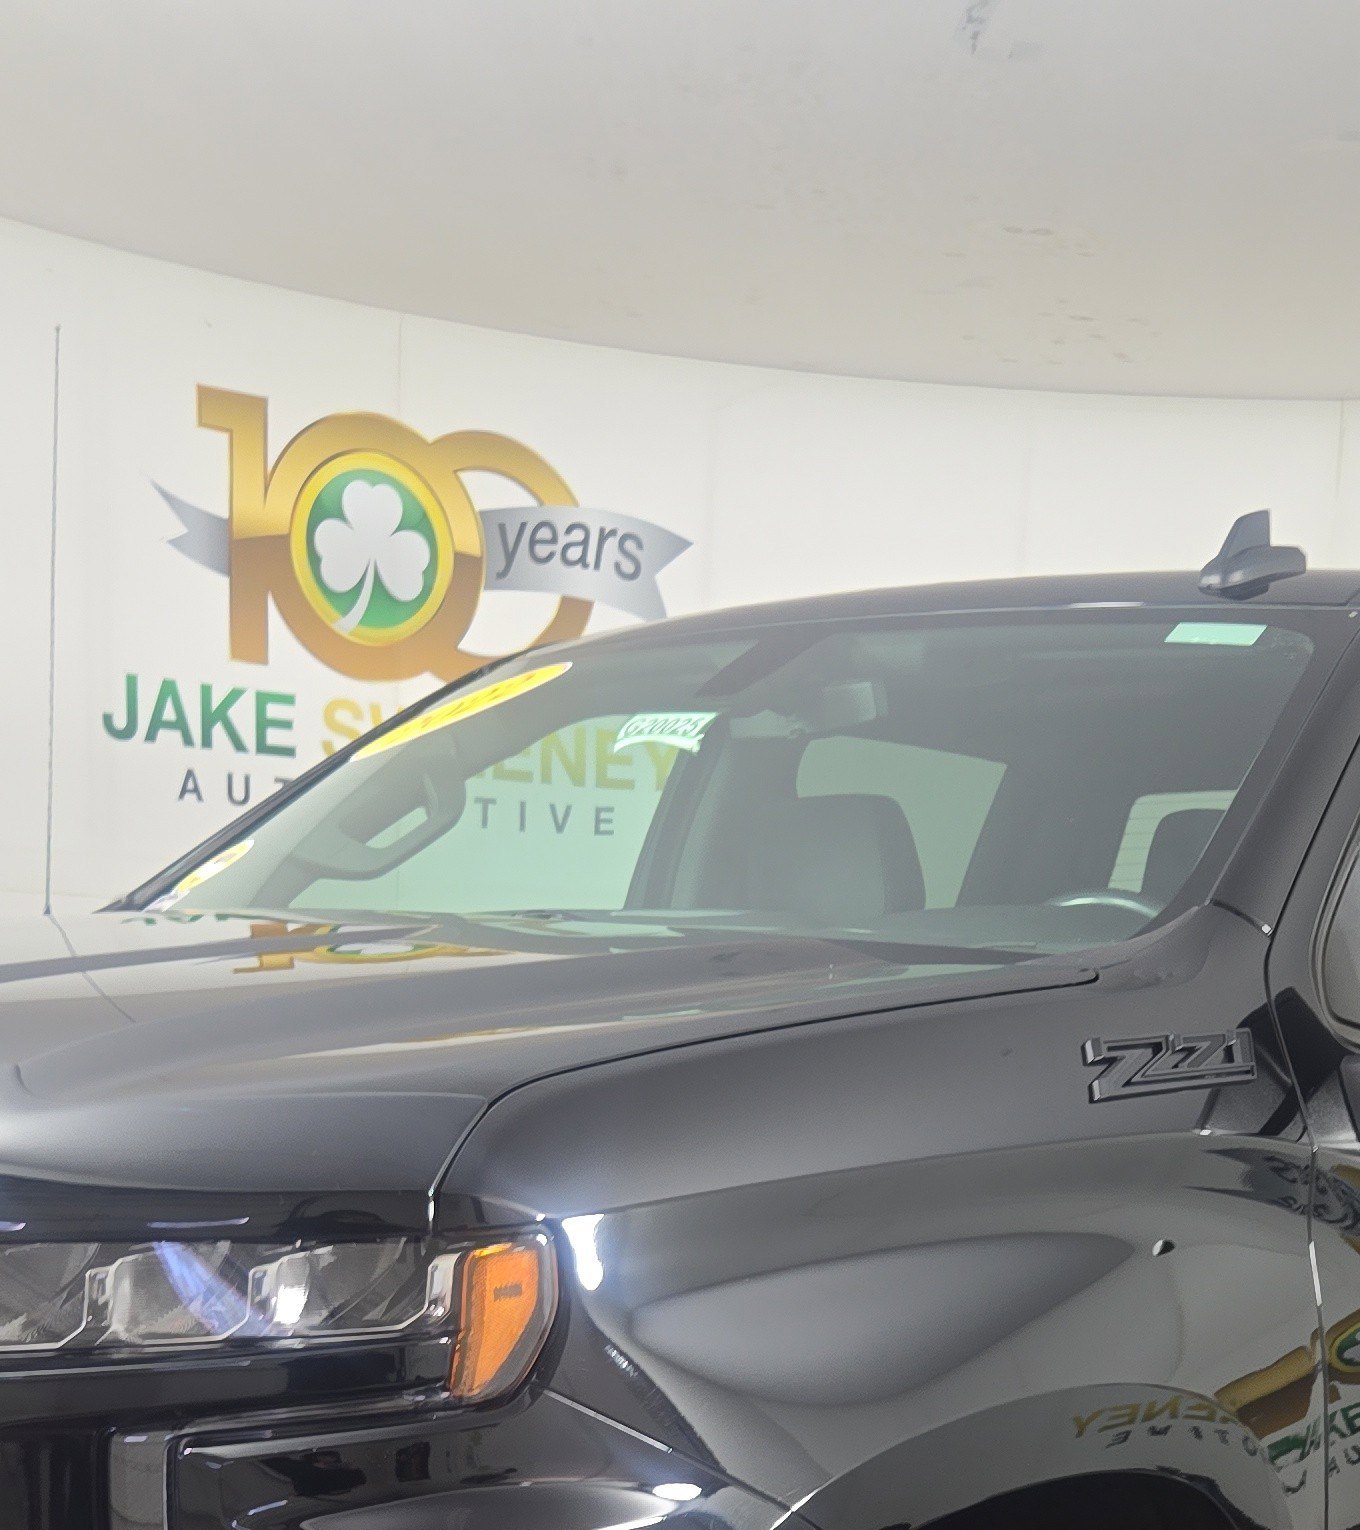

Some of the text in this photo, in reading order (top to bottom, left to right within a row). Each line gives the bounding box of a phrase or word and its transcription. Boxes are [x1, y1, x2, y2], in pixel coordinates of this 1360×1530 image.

[494, 518, 645, 582] years
[101, 673, 297, 758] JAKE
[1081, 1027, 1257, 1104] Z71
